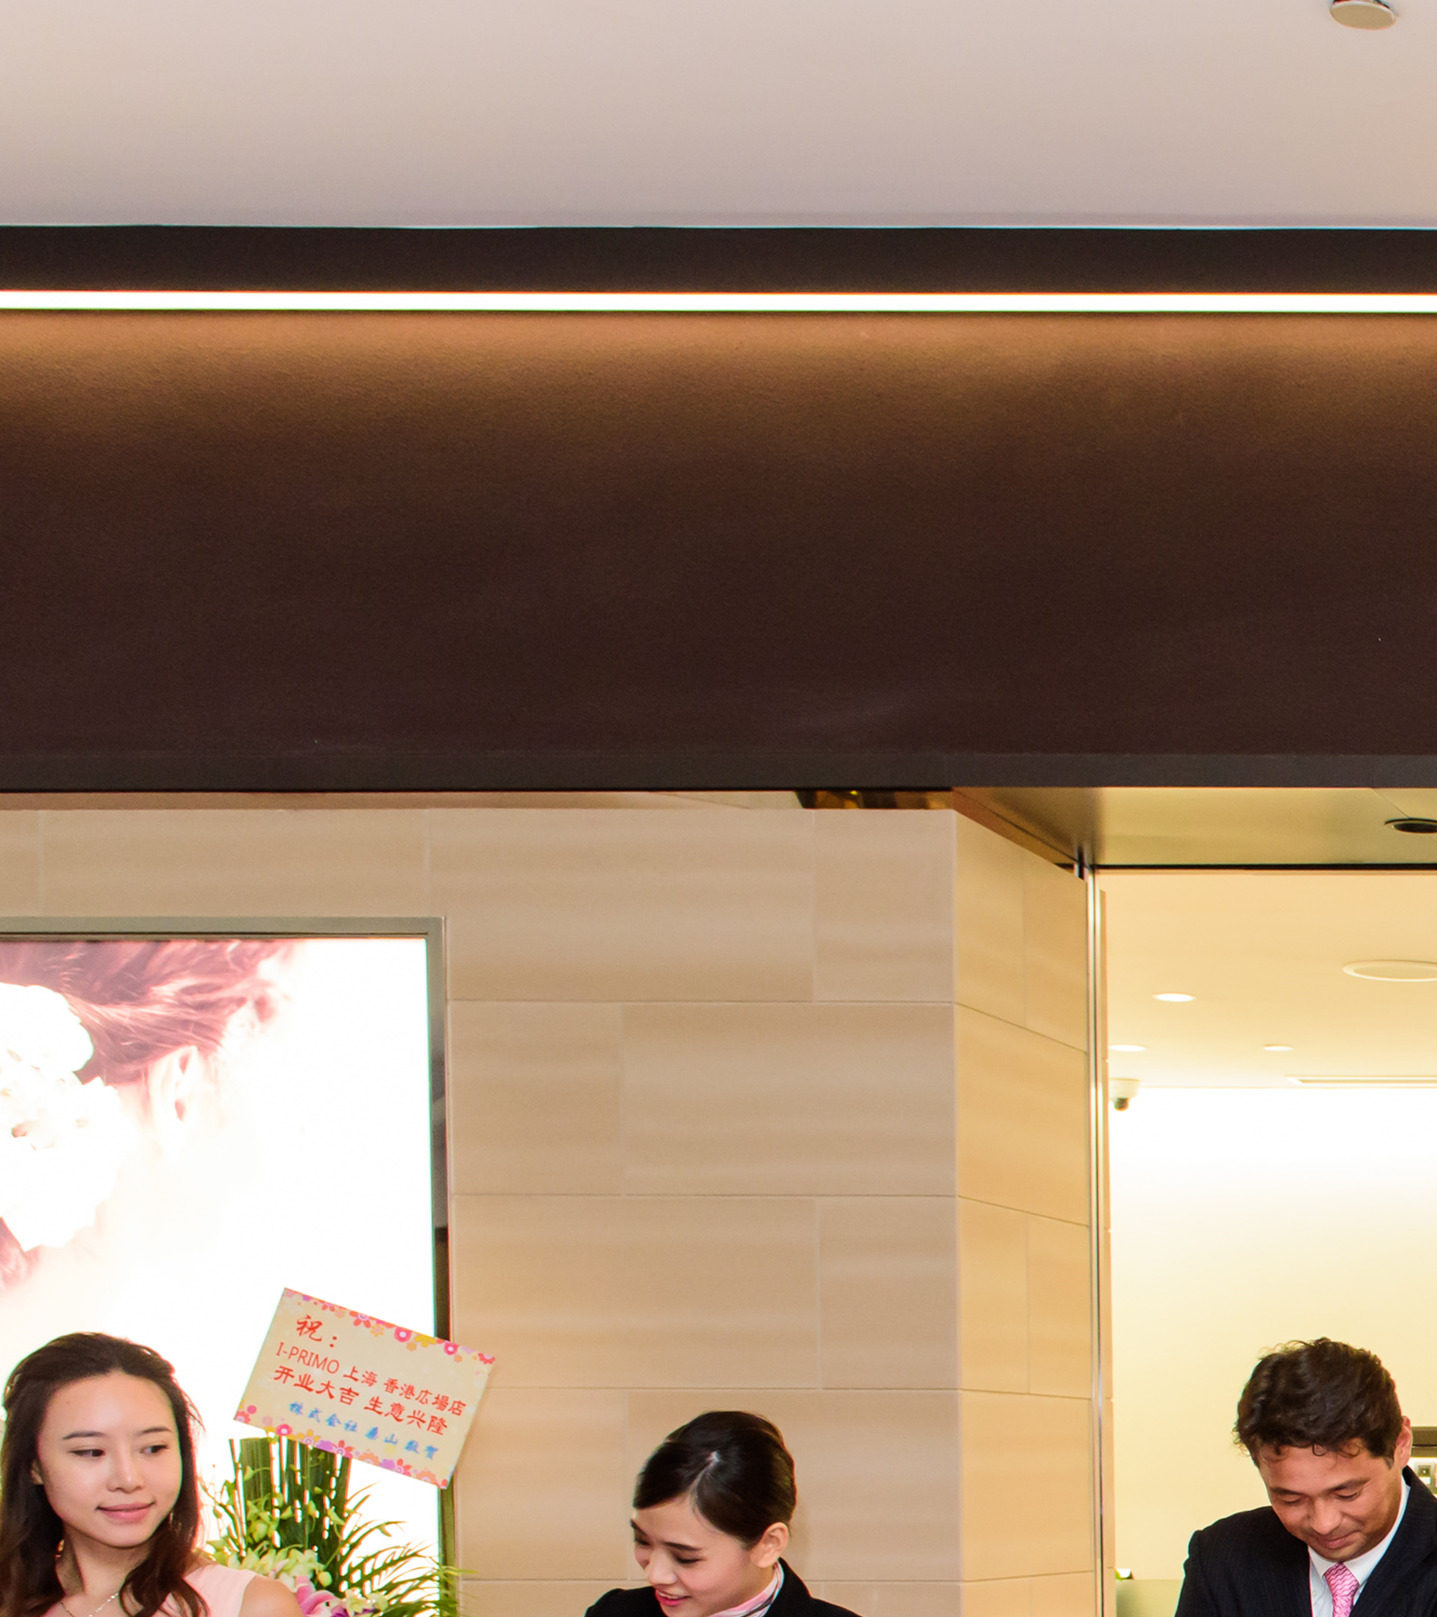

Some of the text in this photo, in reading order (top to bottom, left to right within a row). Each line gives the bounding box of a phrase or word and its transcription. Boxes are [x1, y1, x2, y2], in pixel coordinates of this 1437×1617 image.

[276, 1341, 340, 1375] I-PRIMO
[343, 1365, 378, 1387] 上海
[273, 1365, 448, 1436] 开业大吉 生意兴隆
